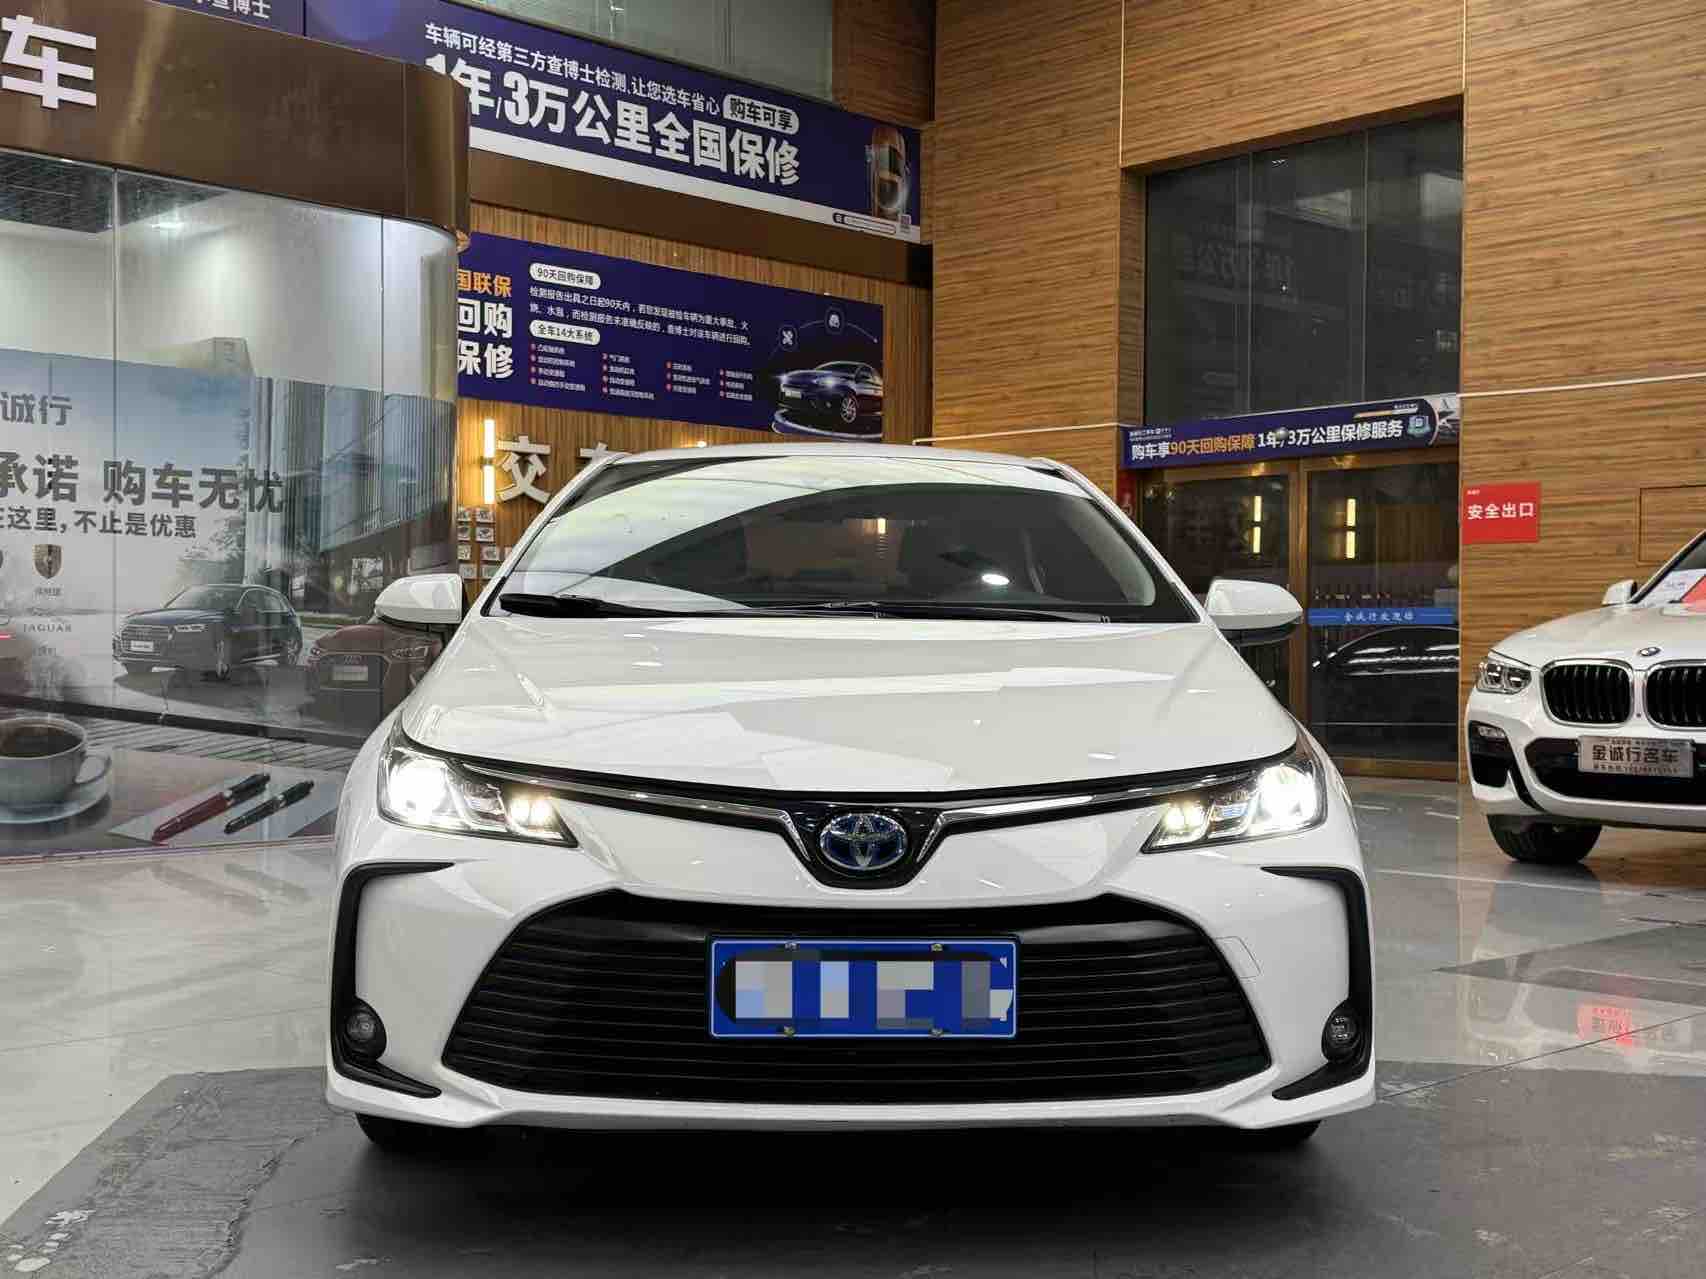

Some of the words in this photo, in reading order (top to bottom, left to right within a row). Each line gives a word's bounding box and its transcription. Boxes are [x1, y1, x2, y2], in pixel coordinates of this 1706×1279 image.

[1, 13, 97, 110] 车
[730, 97, 794, 131] 购车可享
[457, 268, 512, 298] 国联保
[537, 266, 595, 287] 90天回购保障
[457, 298, 513, 339] 回购
[537, 323, 594, 341] 全车14大系统
[457, 339, 514, 379] 保修
[0, 391, 72, 426] 诚行
[1131, 433, 1256, 461] 购车享90天回购保障
[103, 460, 286, 514] 购车无忧
[0, 504, 197, 538] 这里，不止是优惠
[1467, 502, 1535, 520] 安全出口
